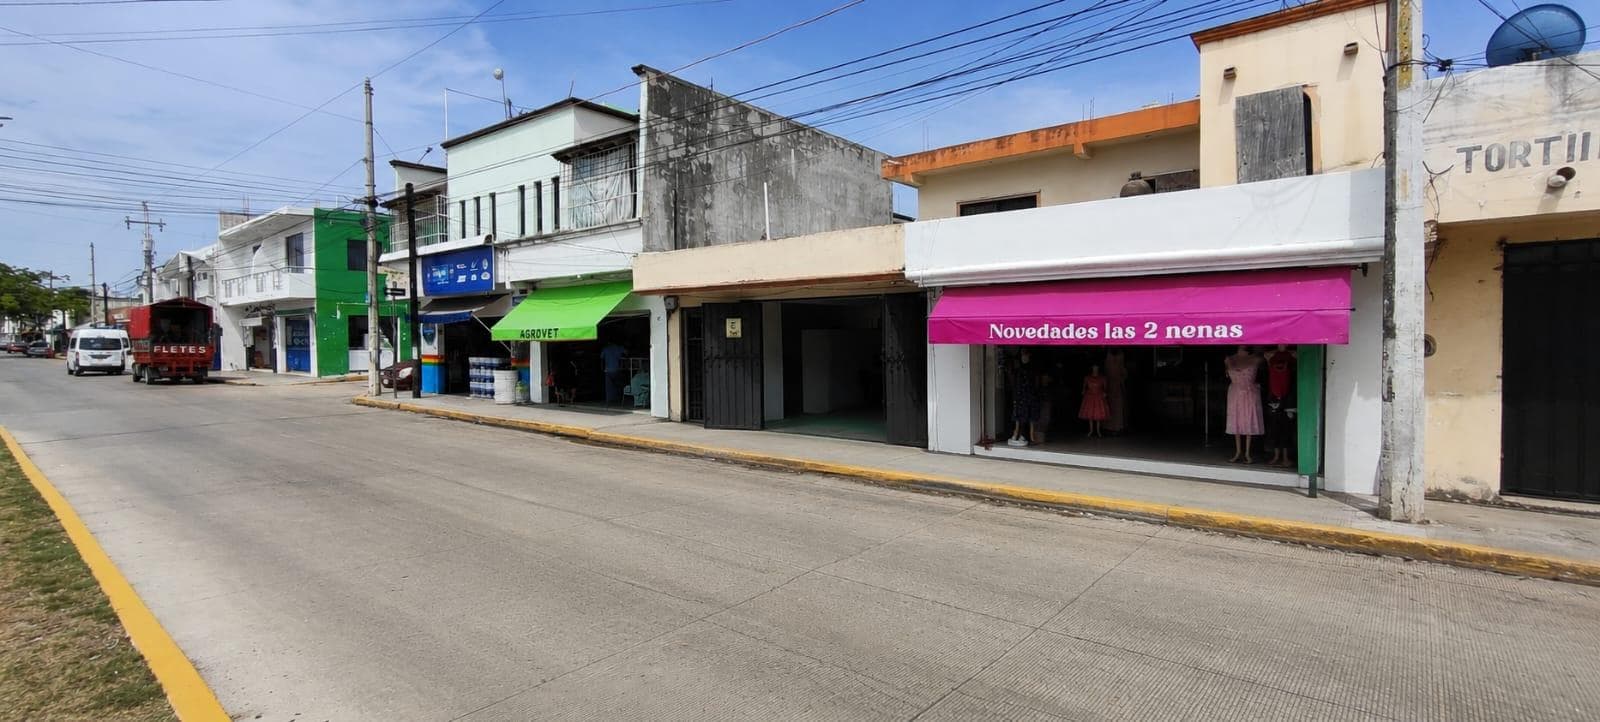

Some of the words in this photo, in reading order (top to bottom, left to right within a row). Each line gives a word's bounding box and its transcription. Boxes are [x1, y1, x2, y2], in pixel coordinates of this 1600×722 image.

[519, 328, 559, 339] AGROVET
[988, 323, 1098, 339] Novedades
[1104, 322, 1136, 338] las
[1143, 322, 1158, 338] 2
[1165, 323, 1243, 338] nenas
[153, 345, 207, 354] FLETES
